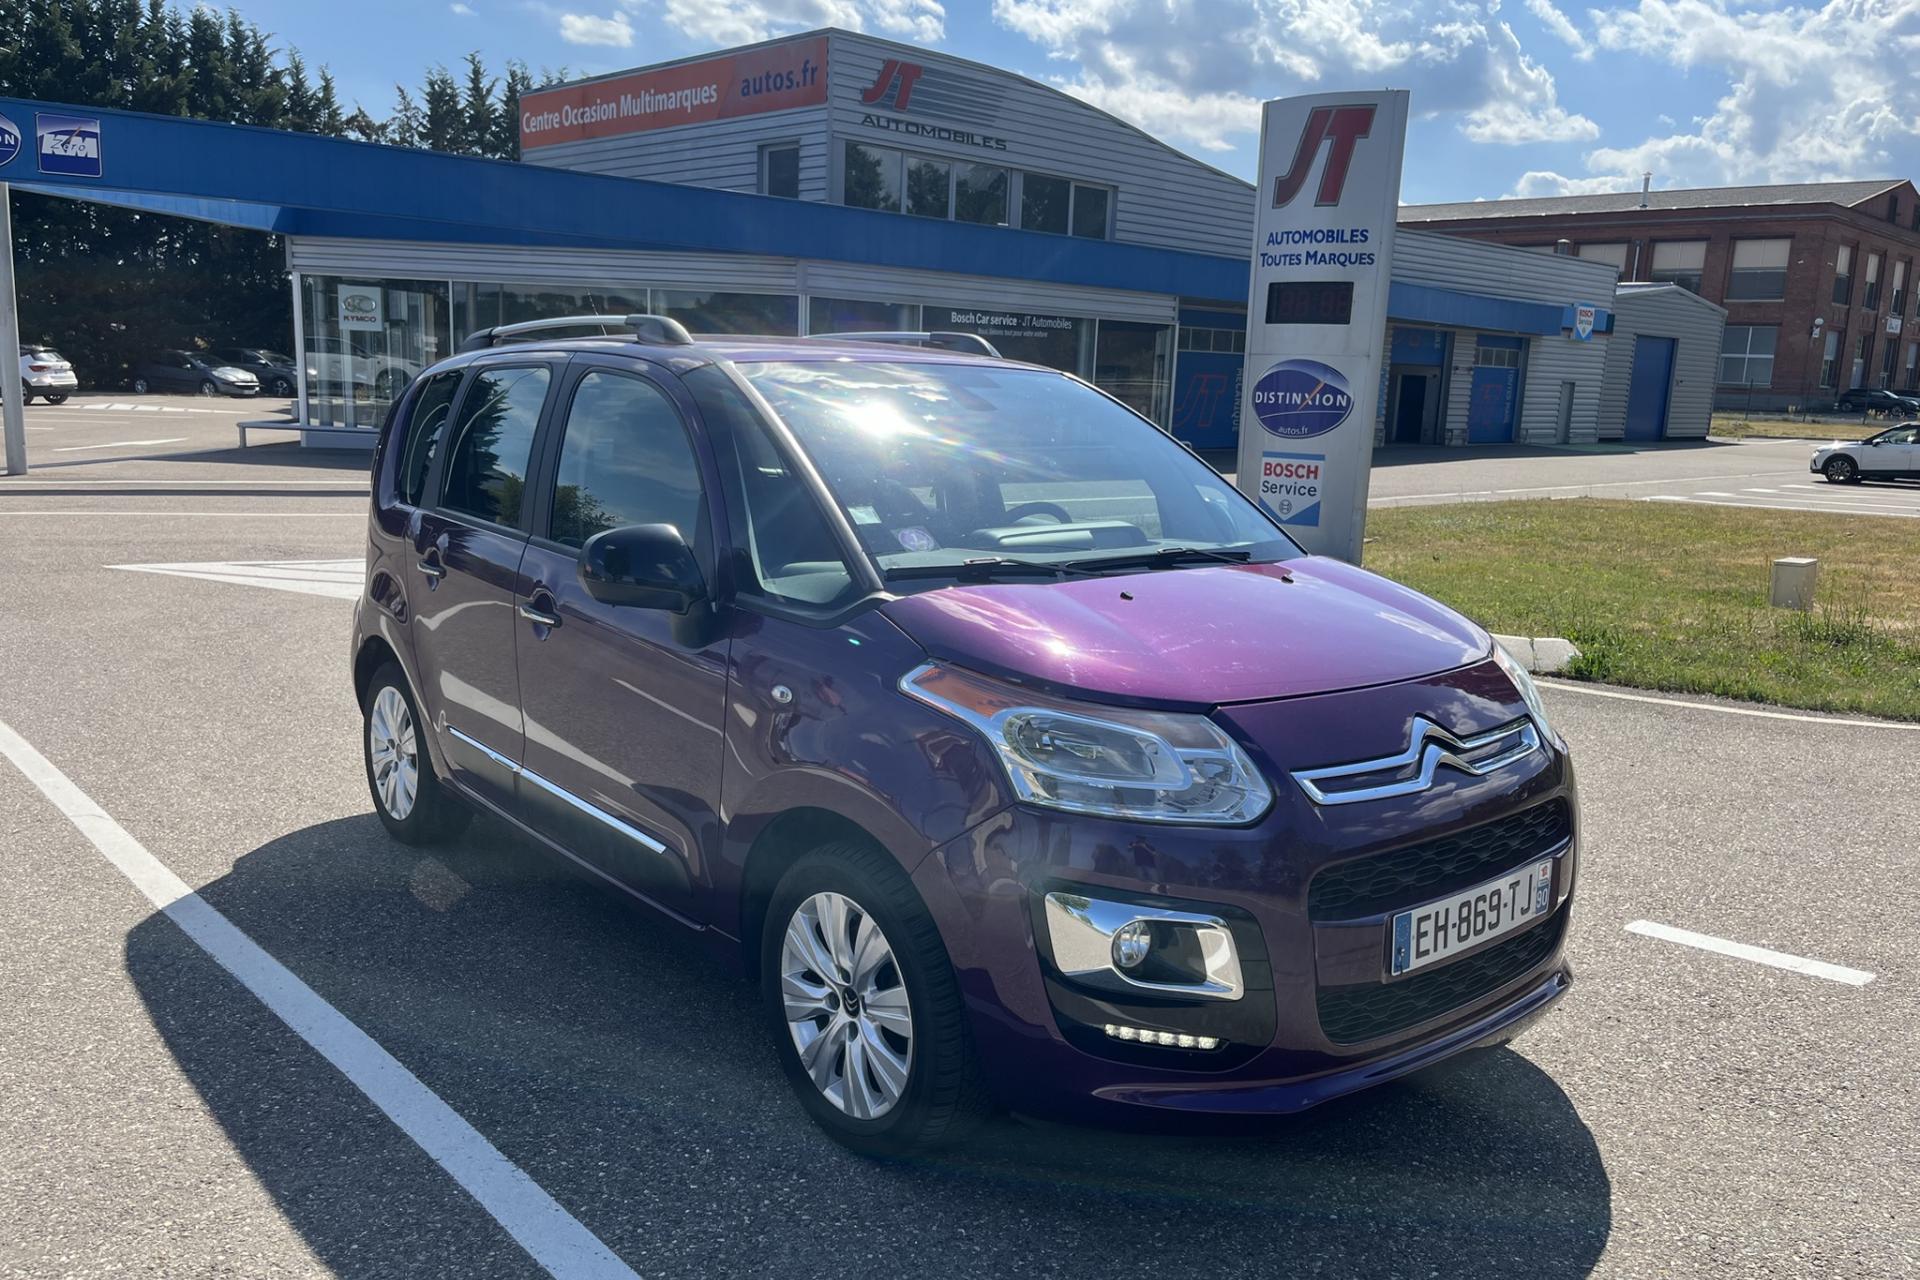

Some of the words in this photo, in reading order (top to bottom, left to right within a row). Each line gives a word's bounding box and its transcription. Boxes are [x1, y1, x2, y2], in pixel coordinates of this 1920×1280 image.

[741, 59, 818, 97] autos.fr
[862, 59, 924, 112] JT
[523, 110, 559, 134] Centre
[562, 98, 617, 127] Occasion
[620, 83, 718, 119] Multimarques
[860, 114, 1008, 151] AUTOMOBILES
[1272, 104, 1377, 209] JT
[1266, 229, 1369, 246] AUTOMOBILES
[1260, 252, 1302, 268] TOUTES
[1305, 250, 1375, 267] MARQUES
[344, 315, 376, 323] KYMCO
[951, 311, 975, 324] Bosch
[976, 313, 989, 325] Car
[990, 315, 1017, 326] service
[1022, 316, 1031, 327] JT
[1031, 316, 1072, 330] Automobiles
[1255, 391, 1347, 407] DISTINXION
[1278, 426, 1309, 436] autos.fr
[1263, 462, 1319, 480] BOSCH
[1261, 480, 1317, 497] Service
[1415, 874, 1533, 960] EH-869-TJ
[1536, 887, 1548, 908] 90
